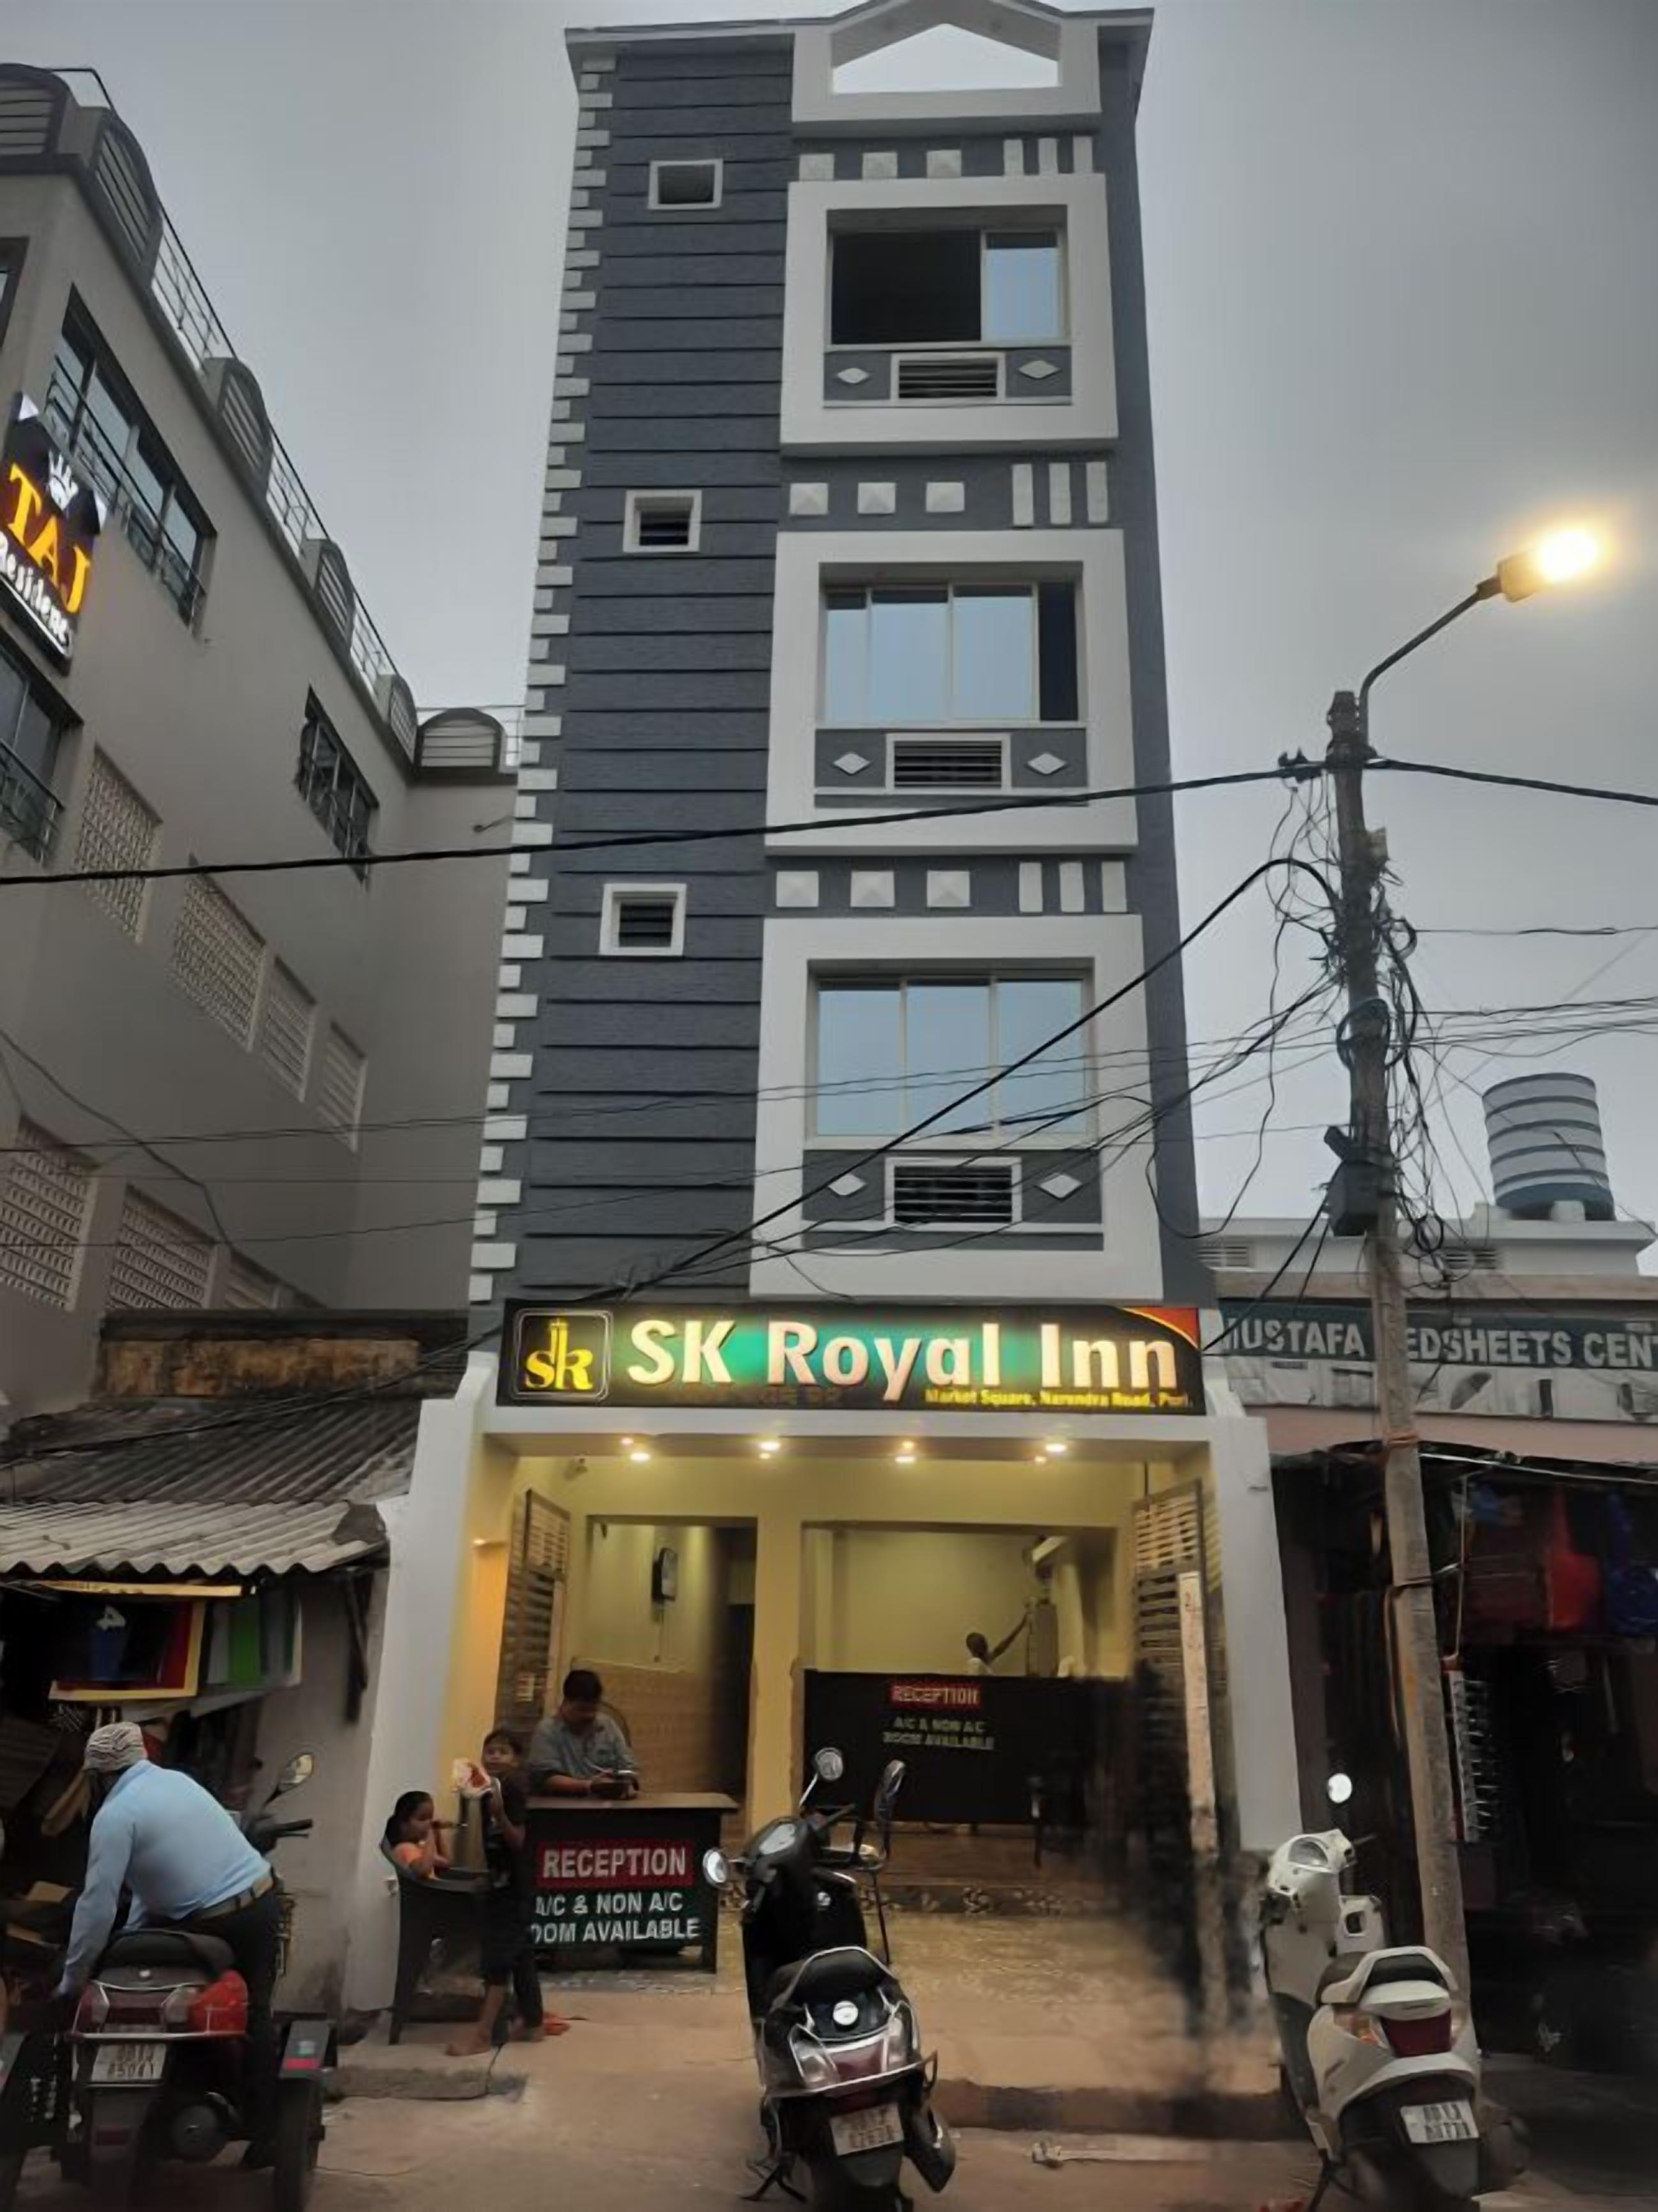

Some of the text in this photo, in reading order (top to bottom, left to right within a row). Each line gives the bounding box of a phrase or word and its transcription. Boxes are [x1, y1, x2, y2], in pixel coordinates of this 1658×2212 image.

[8, 463, 91, 614] TAJ
[627, 1319, 1177, 1402] SK Royal Inn
[1406, 1328, 1572, 1365] EDSHEETS
[543, 1846, 686, 1879] RECEPTION
[572, 1895, 588, 1914] &
[595, 1891, 642, 1914] NON
[531, 1916, 701, 1943] OOM AVAILABLE
